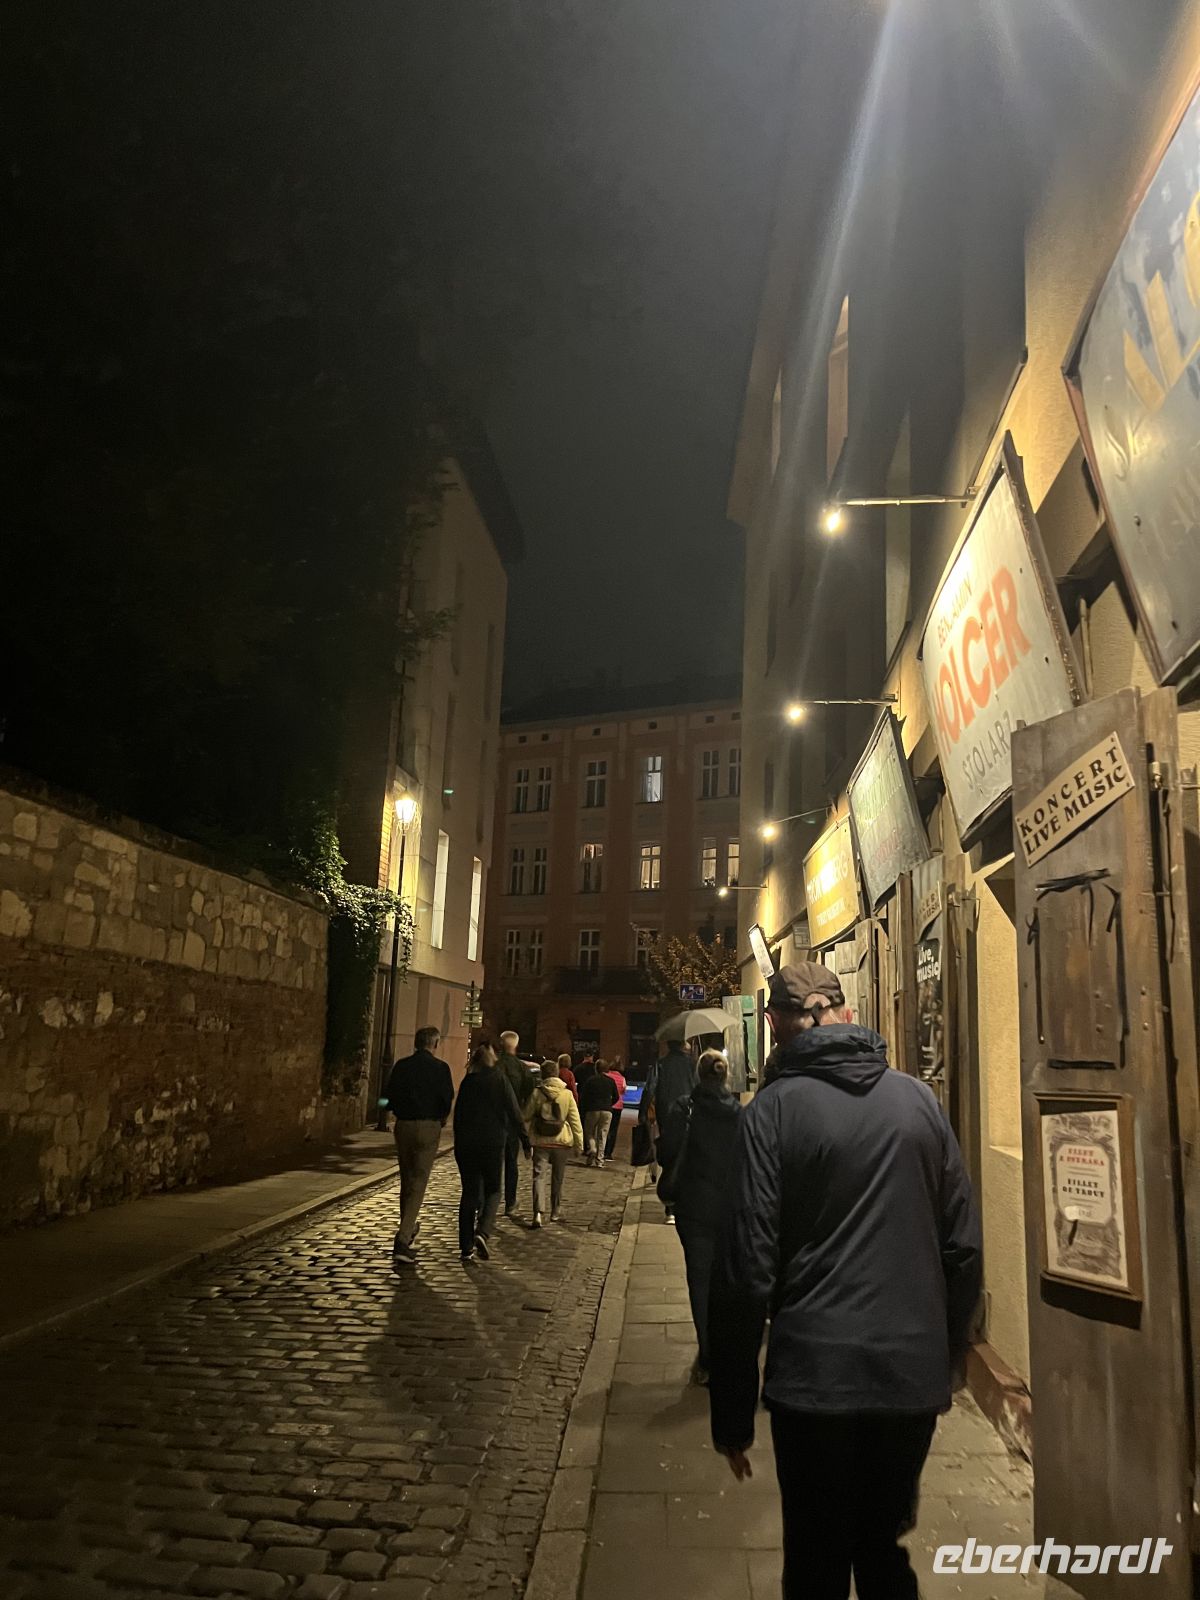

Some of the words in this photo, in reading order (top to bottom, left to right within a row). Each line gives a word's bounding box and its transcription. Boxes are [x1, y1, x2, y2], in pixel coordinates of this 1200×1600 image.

[933, 566, 1032, 758] HOLCER
[1018, 746, 1119, 838] KONCERT
[1023, 815, 1062, 856] LIVE
[1063, 765, 1127, 823] MUSIC
